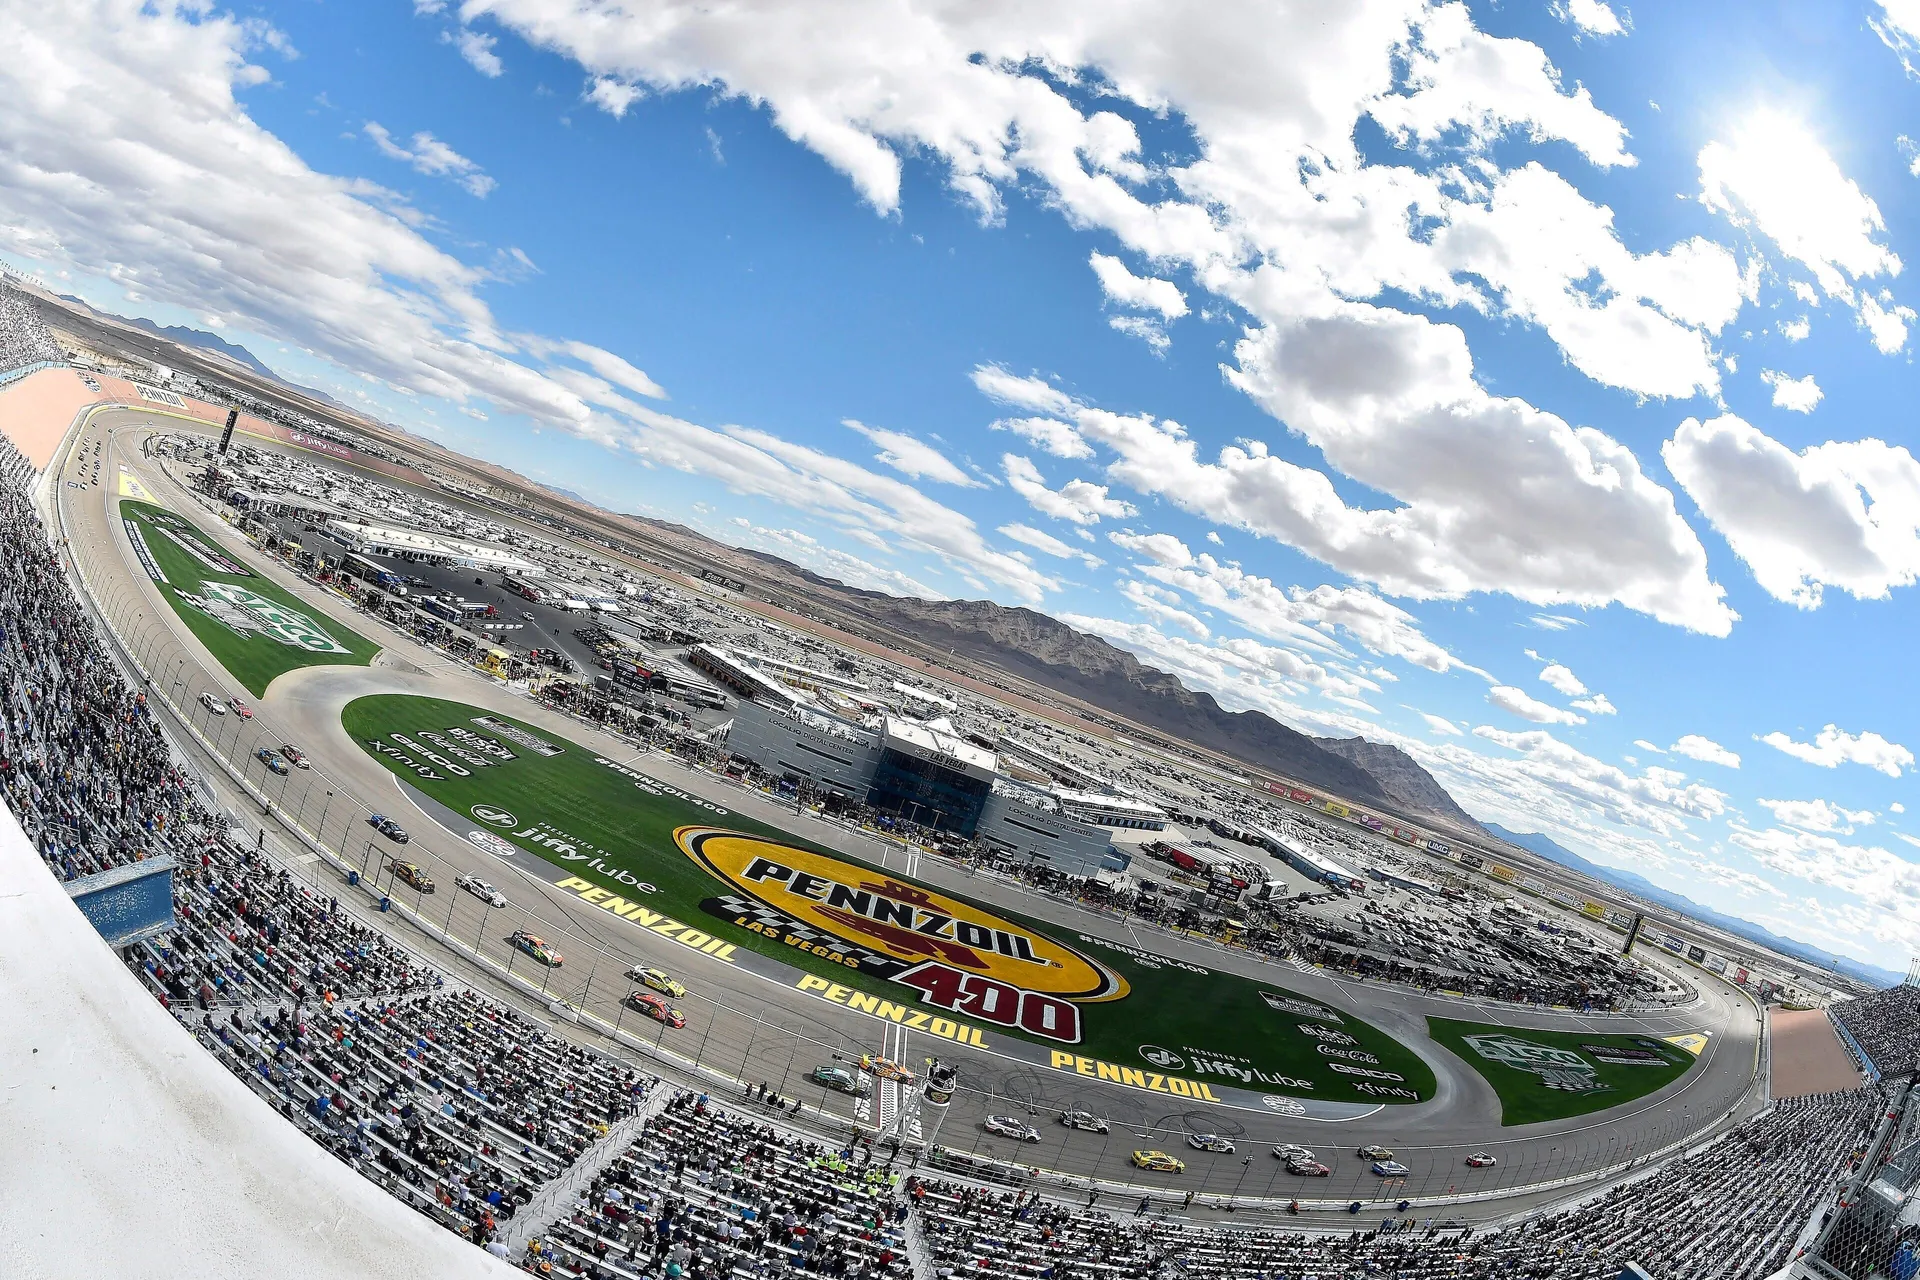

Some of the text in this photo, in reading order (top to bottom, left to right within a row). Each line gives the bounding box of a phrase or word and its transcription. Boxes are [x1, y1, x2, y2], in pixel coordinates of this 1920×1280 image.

[136, 384, 185, 407] PENNZOIL
[333, 526, 356, 541] SUNOCO
[368, 740, 445, 780] xfinity
[390, 733, 471, 776] GEICO
[449, 727, 518, 760] BUSCH
[803, 732, 828, 748] DIGITAL
[828, 741, 855, 755] CENTER
[929, 751, 968, 772] LAS VEGAS
[539, 822, 613, 858] PRESENTED BY
[1046, 819, 1070, 832] DIGITAL
[1070, 826, 1094, 838] CENTER
[553, 876, 740, 962] PENNZOIL
[740, 856, 1053, 967] PENNZOIL
[734, 916, 861, 969] LAS VEGAS
[796, 973, 991, 1050] PENNZOIL
[890, 960, 1085, 1044] 400
[1297, 1024, 1361, 1046] BUSCH
[1183, 1046, 1240, 1062] PRESENTED
[1051, 1050, 1221, 1102] PENNZOIL
[1329, 1063, 1404, 1082] GEICO
[1352, 1082, 1418, 1101] xfinity
